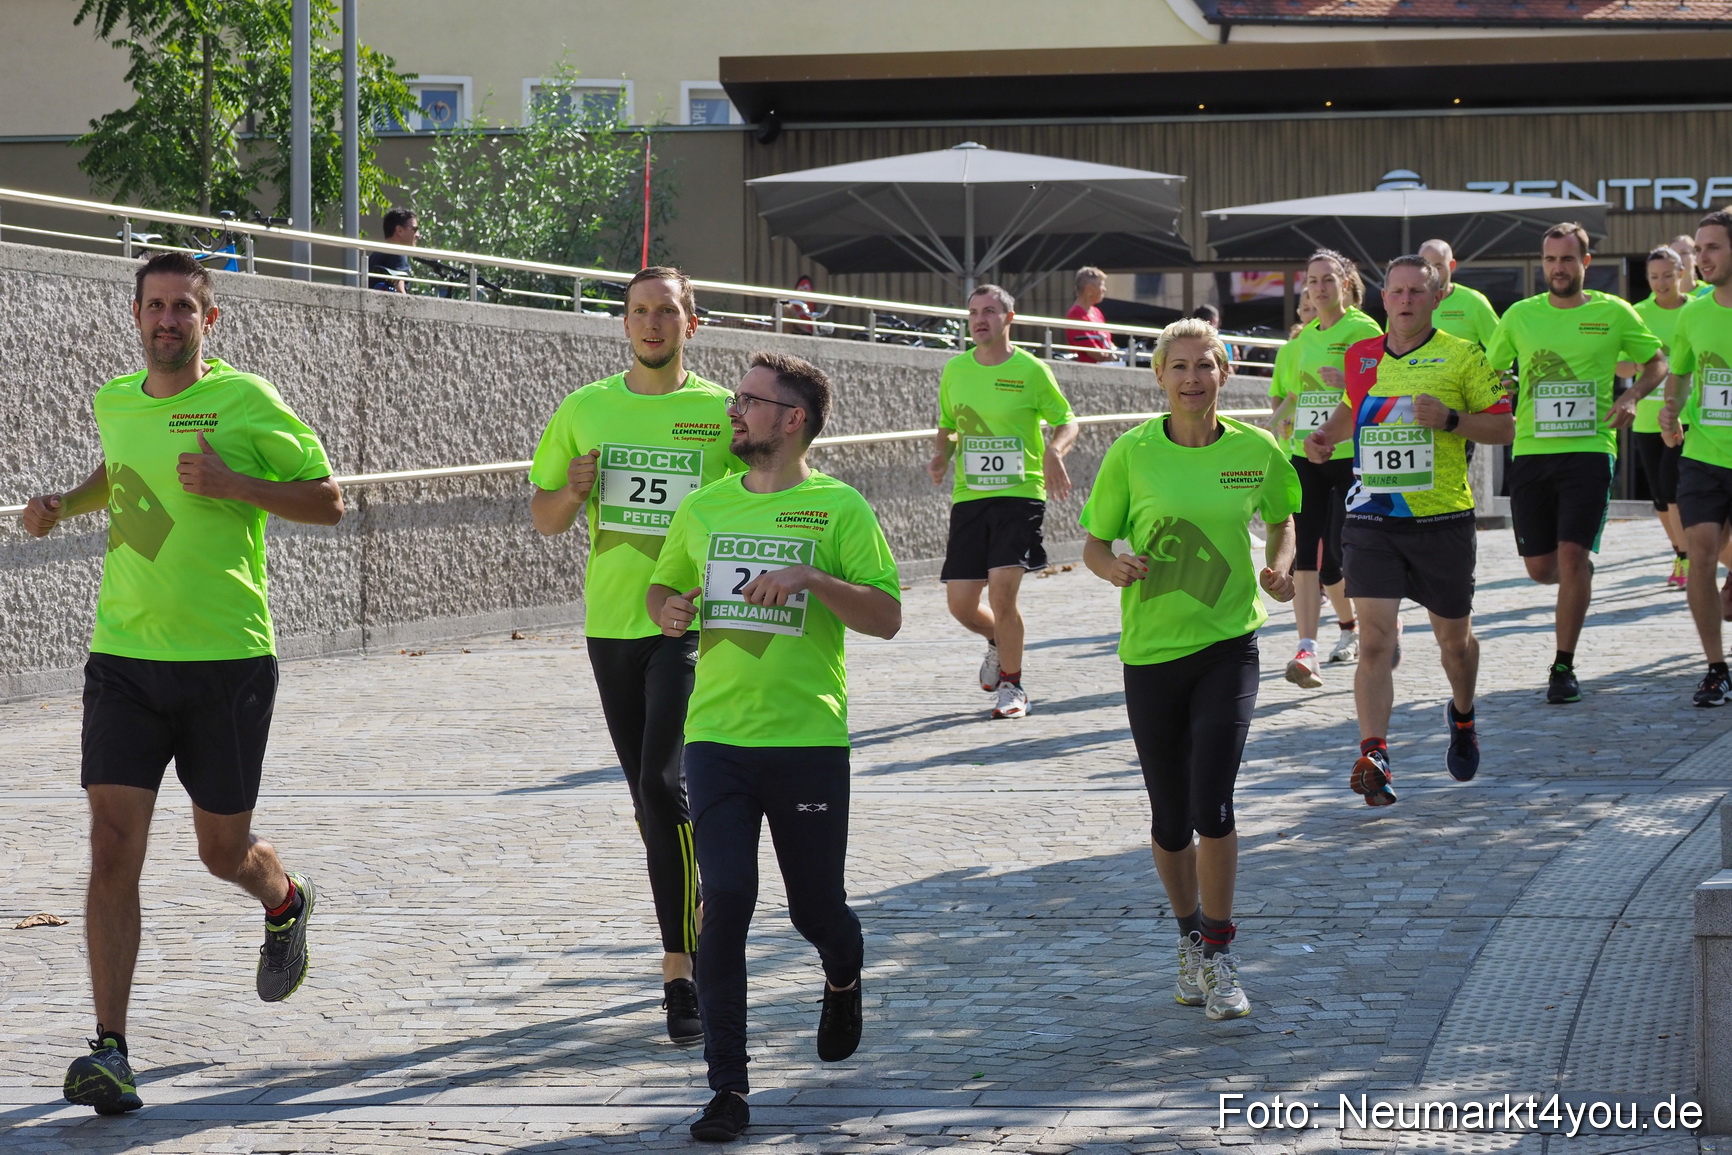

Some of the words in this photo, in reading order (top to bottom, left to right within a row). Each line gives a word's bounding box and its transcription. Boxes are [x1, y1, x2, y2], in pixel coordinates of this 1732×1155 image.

[1538, 384, 1590, 397] BOCK
[1720, 390, 1732, 406] 1
[1300, 393, 1341, 406] BOCK
[1310, 410, 1328, 426] 21
[1553, 402, 1576, 418] 17
[1706, 411, 1732, 419] CHRIS
[1540, 422, 1590, 431] SEBASTIAN
[1364, 428, 1427, 444] BOCK
[967, 438, 1017, 451] BOCK
[608, 447, 693, 473] BOCK
[980, 456, 1004, 472] 20
[1374, 449, 1416, 470] 181
[978, 476, 1008, 484] PETER
[629, 477, 667, 505] 25
[623, 511, 671, 525] PETER
[775, 516, 829, 526] ELEMENTELAUF
[780, 510, 828, 518] NEUMARKTER
[714, 537, 803, 564] BOCK
[732, 567, 769, 595] 2
[711, 604, 792, 623] BENJAMIN
